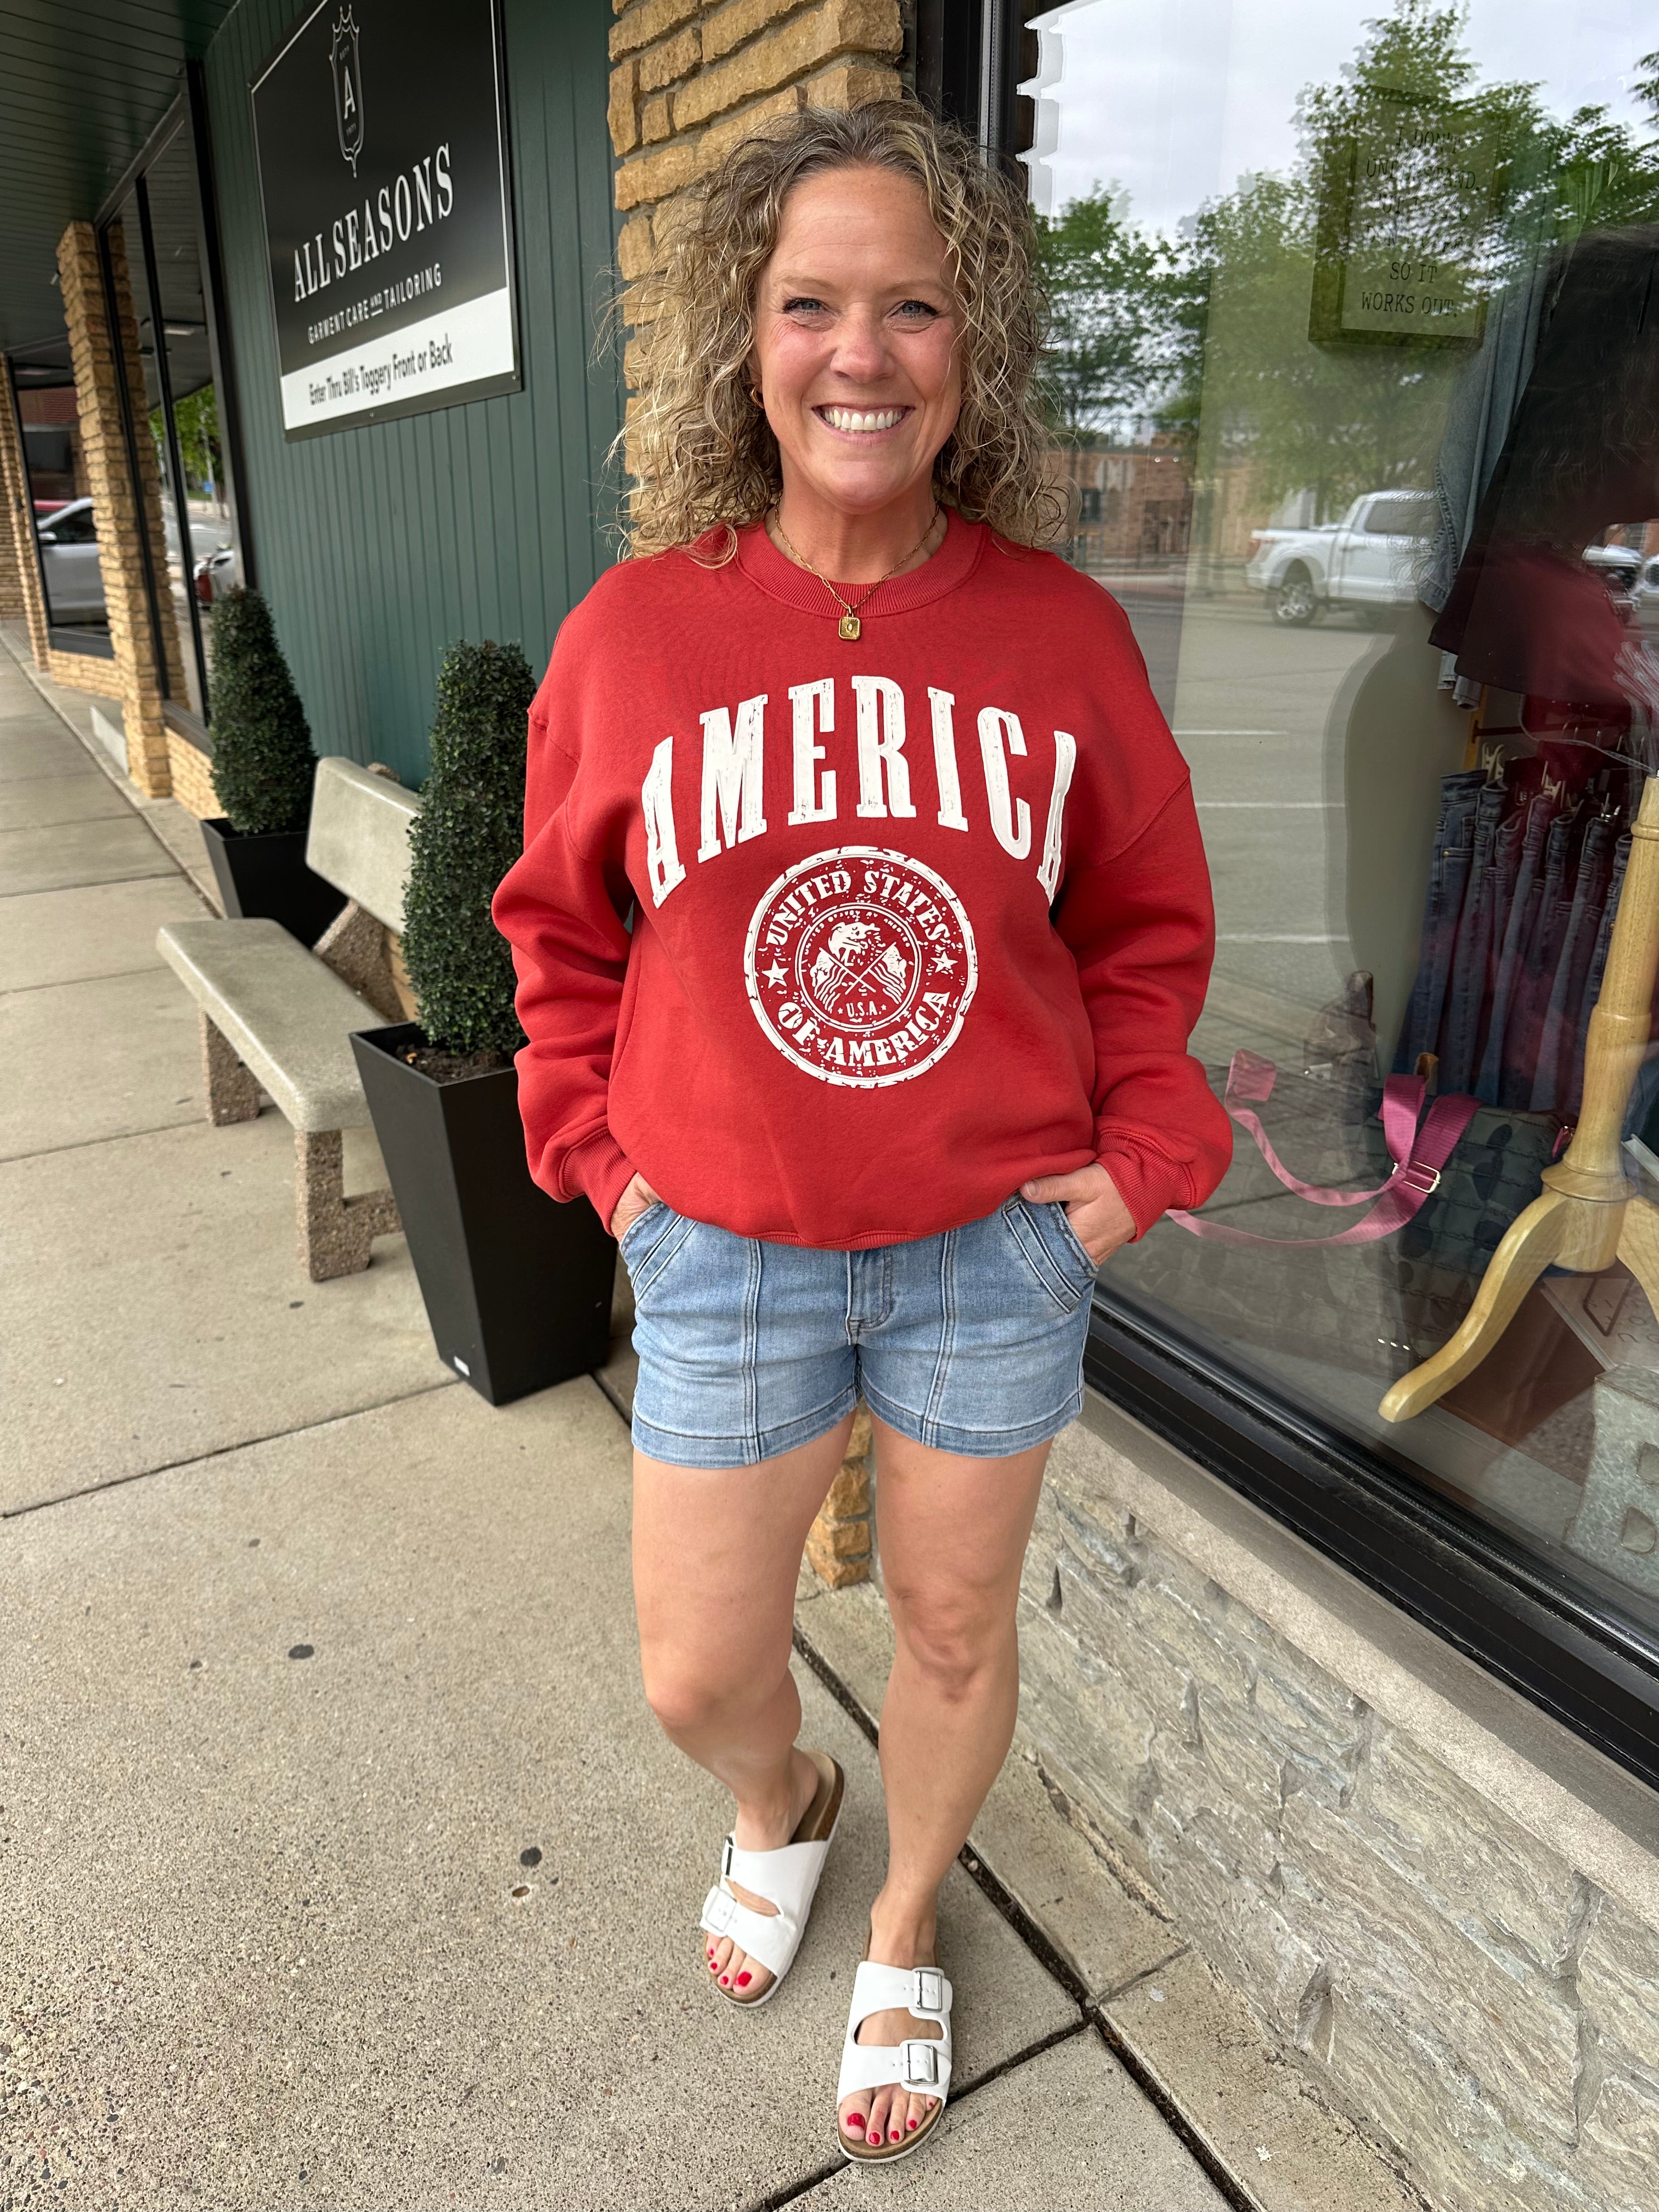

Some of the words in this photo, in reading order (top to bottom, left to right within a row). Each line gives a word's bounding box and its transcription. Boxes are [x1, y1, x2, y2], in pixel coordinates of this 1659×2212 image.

[343, 65, 356, 120] A
[294, 232, 331, 302] ALL
[332, 142, 453, 279] SEASONS
[307, 311, 345, 345] GARMENT
[346, 299, 369, 328] CARE
[370, 292, 383, 308] AND
[383, 262, 442, 310] TAILORING
[1361, 291, 1415, 314] WORKS
[1421, 296, 1458, 318] OUT.
[1390, 262, 1411, 281] SO
[1418, 264, 1437, 283] IT
[308, 383, 327, 405] Enter
[326, 374, 343, 400] Thru
[342, 368, 360, 396] Bill's
[359, 364, 392, 396] Toggery
[392, 349, 417, 380] Front
[417, 351, 427, 373] or
[428, 332, 454, 369] Back
[765, 870, 851, 946] UNITED
[863, 870, 951, 941] STATES
[777, 1001, 821, 1046] OF
[823, 991, 951, 1067] AMERICA
[845, 1000, 882, 1018] U.S.A.
